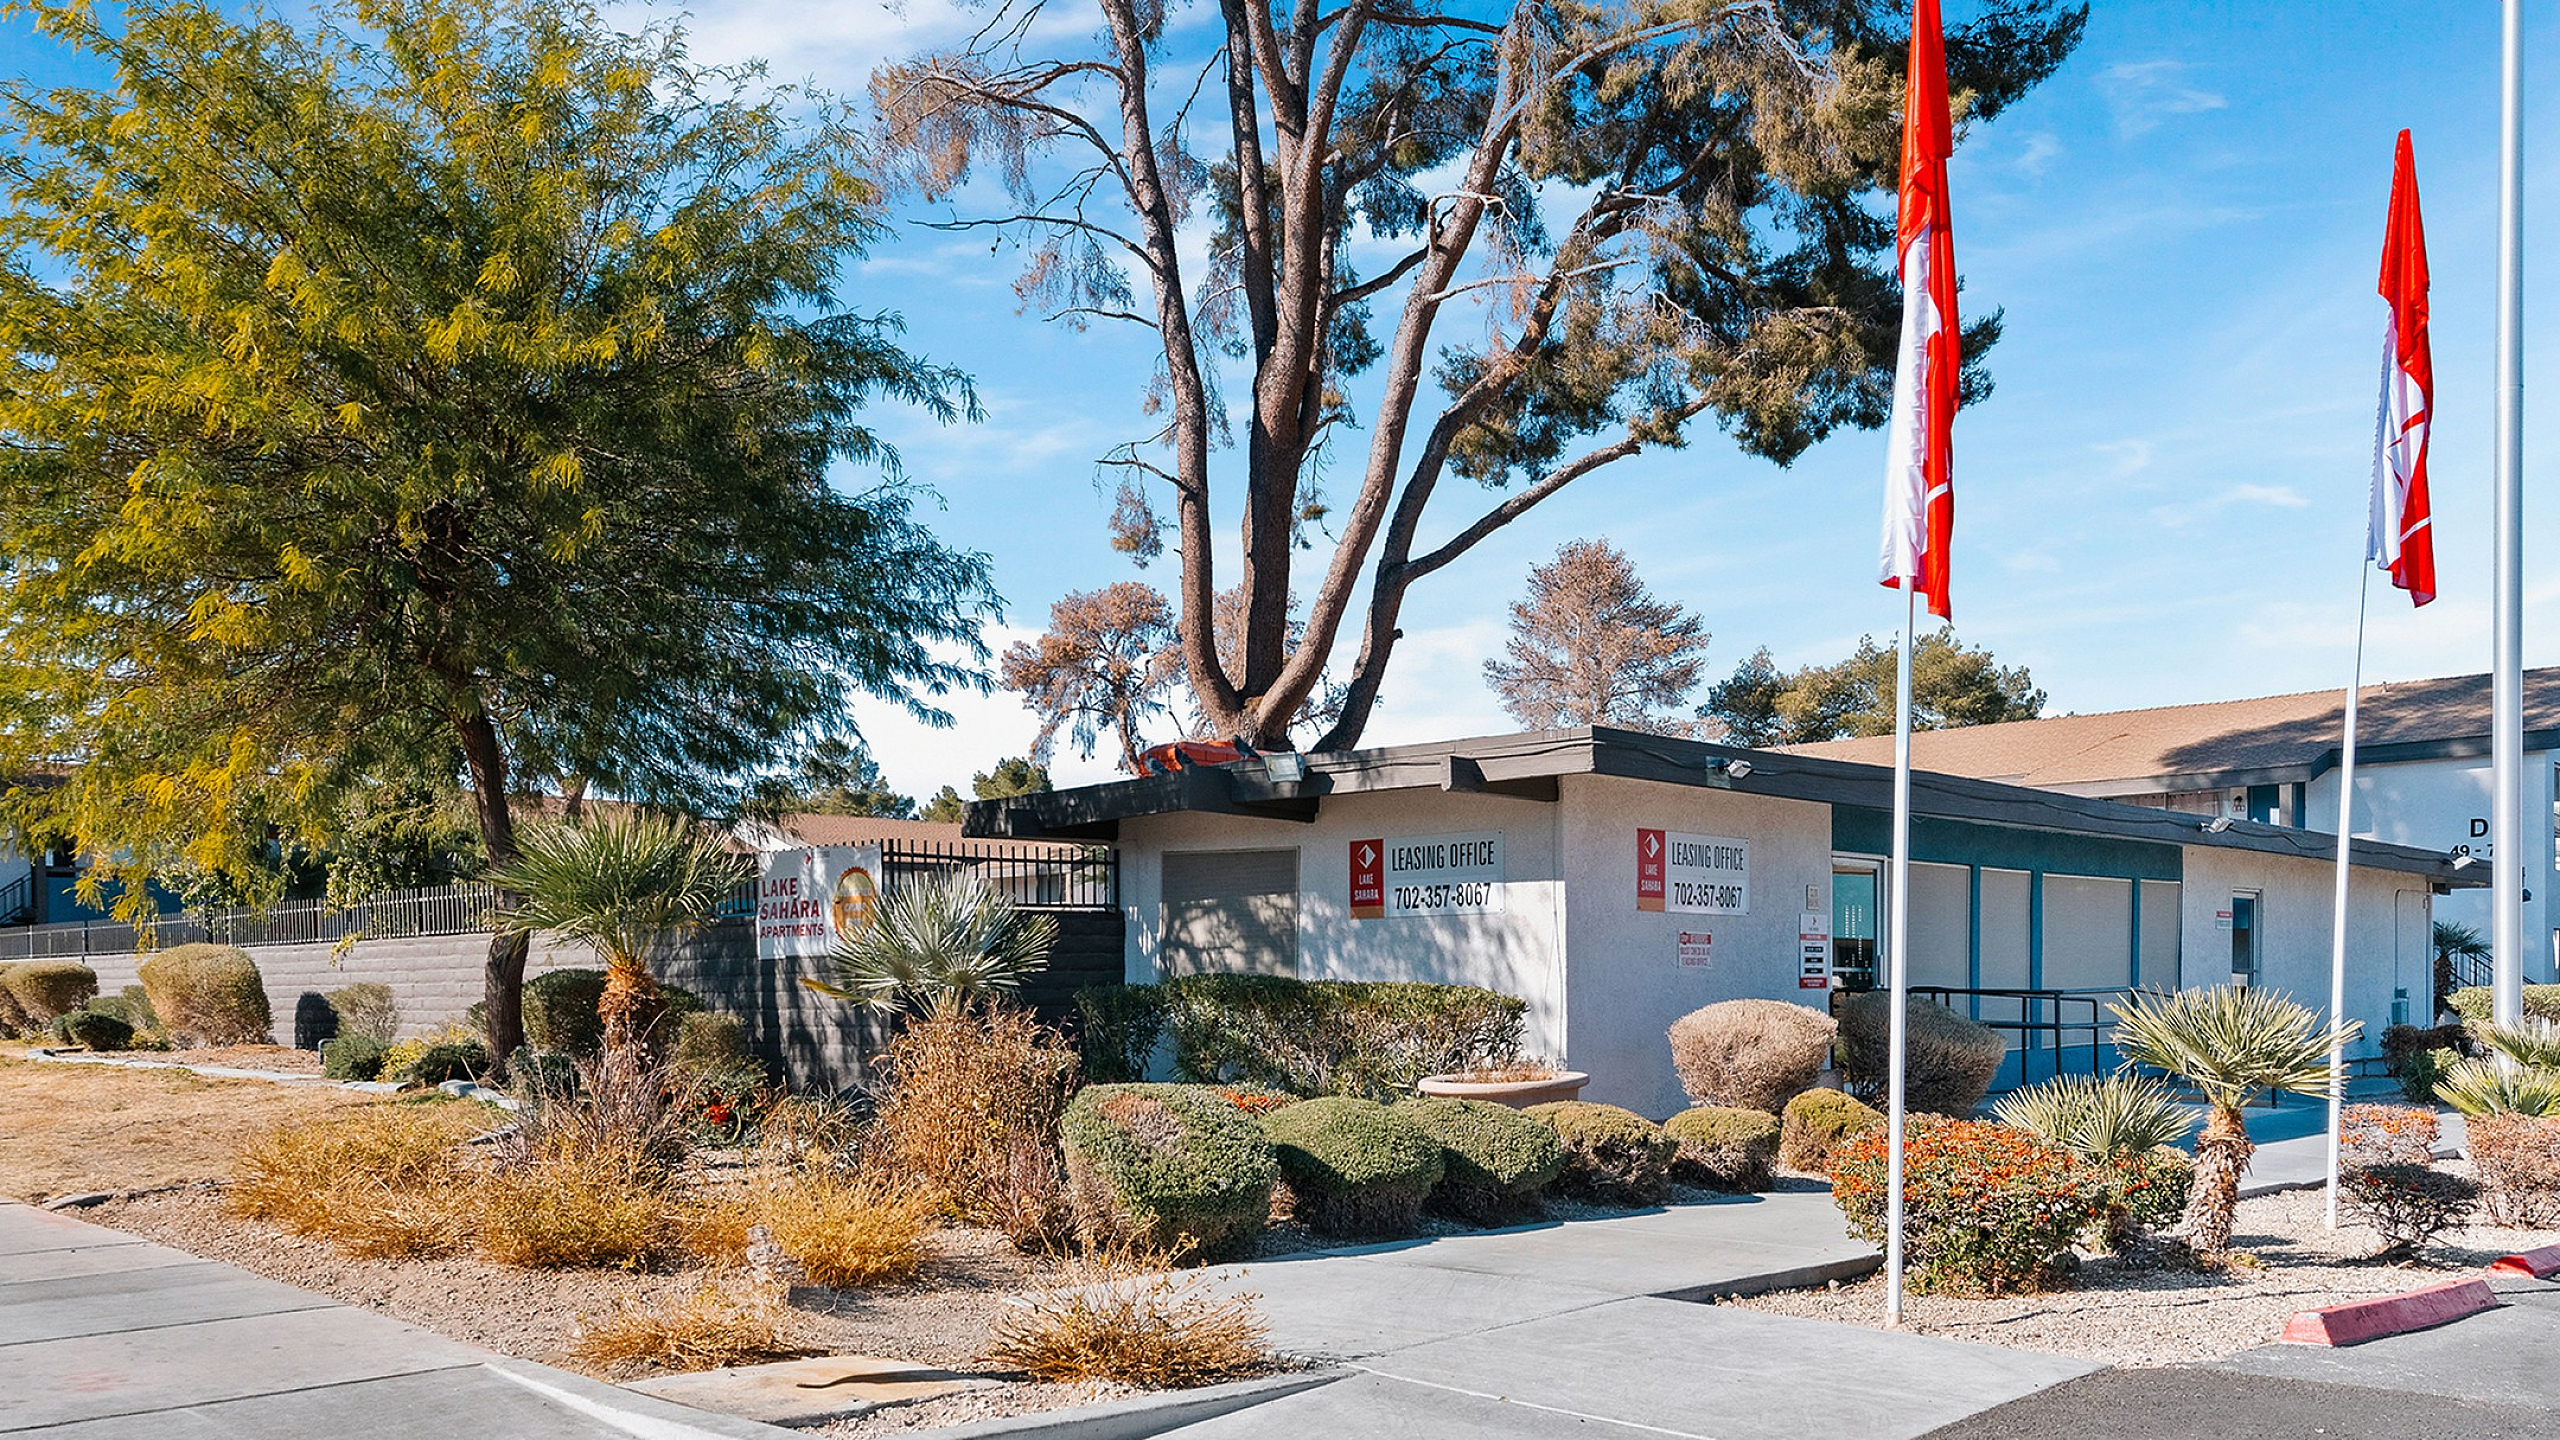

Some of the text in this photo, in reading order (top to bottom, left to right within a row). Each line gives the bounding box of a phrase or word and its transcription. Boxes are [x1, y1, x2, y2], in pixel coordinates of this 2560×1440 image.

[2470, 818, 2489, 837] D
[1392, 841, 1495, 872] LEASING OFFICE
[1672, 842, 1744, 871] LEASING OFFICE
[2450, 844, 2470, 857] 49
[1645, 863, 1658, 876] LAKE
[1358, 873, 1374, 885] LAKE
[1641, 880, 1662, 891] SAHARA
[762, 878, 798, 898] LAKE
[1354, 889, 1379, 901] SAHARA
[1395, 883, 1491, 909] 702-357-8067
[1674, 882, 1743, 909] 702-357-8067
[760, 924, 824, 938] APARTMENTS
